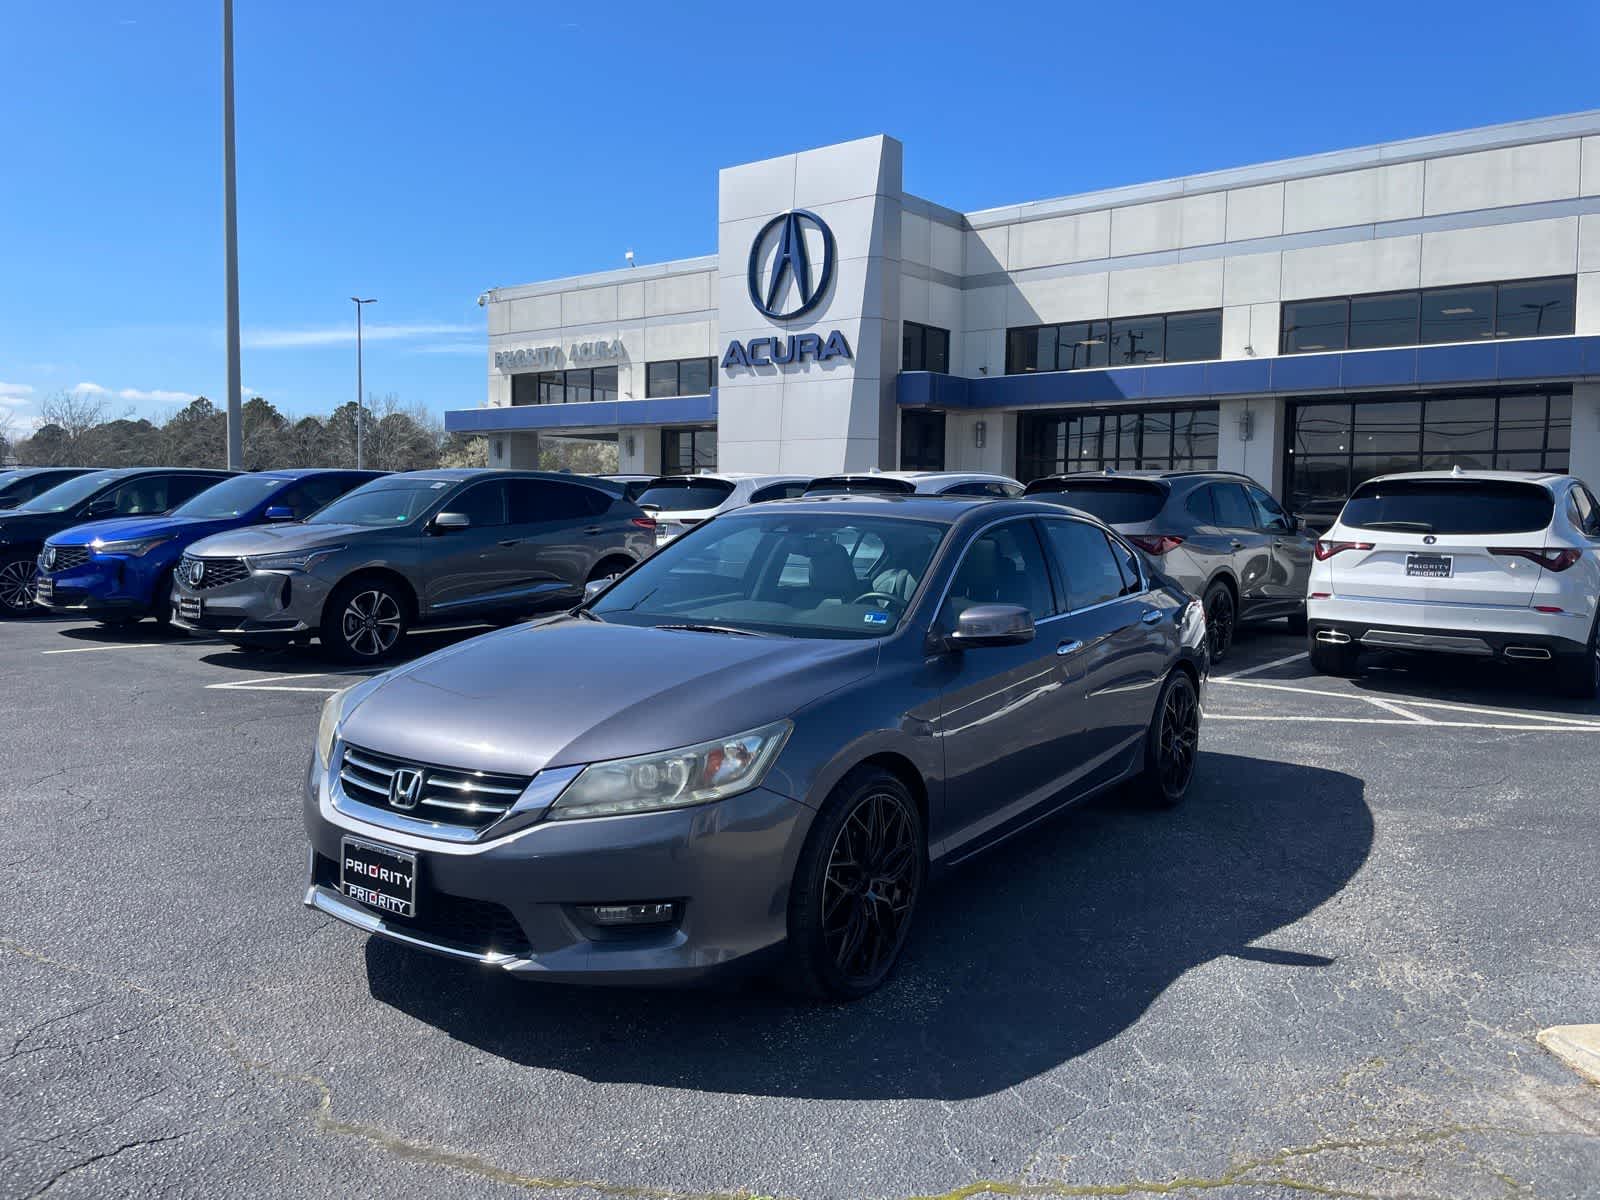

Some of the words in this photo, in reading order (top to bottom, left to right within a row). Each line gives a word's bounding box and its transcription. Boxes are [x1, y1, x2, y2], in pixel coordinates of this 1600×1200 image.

[494, 346, 563, 368] PRIORITY
[569, 339, 624, 361] ACURA
[720, 330, 850, 368] ACURA
[345, 857, 412, 888] PRIORITY
[349, 885, 405, 913] PRIORITY
